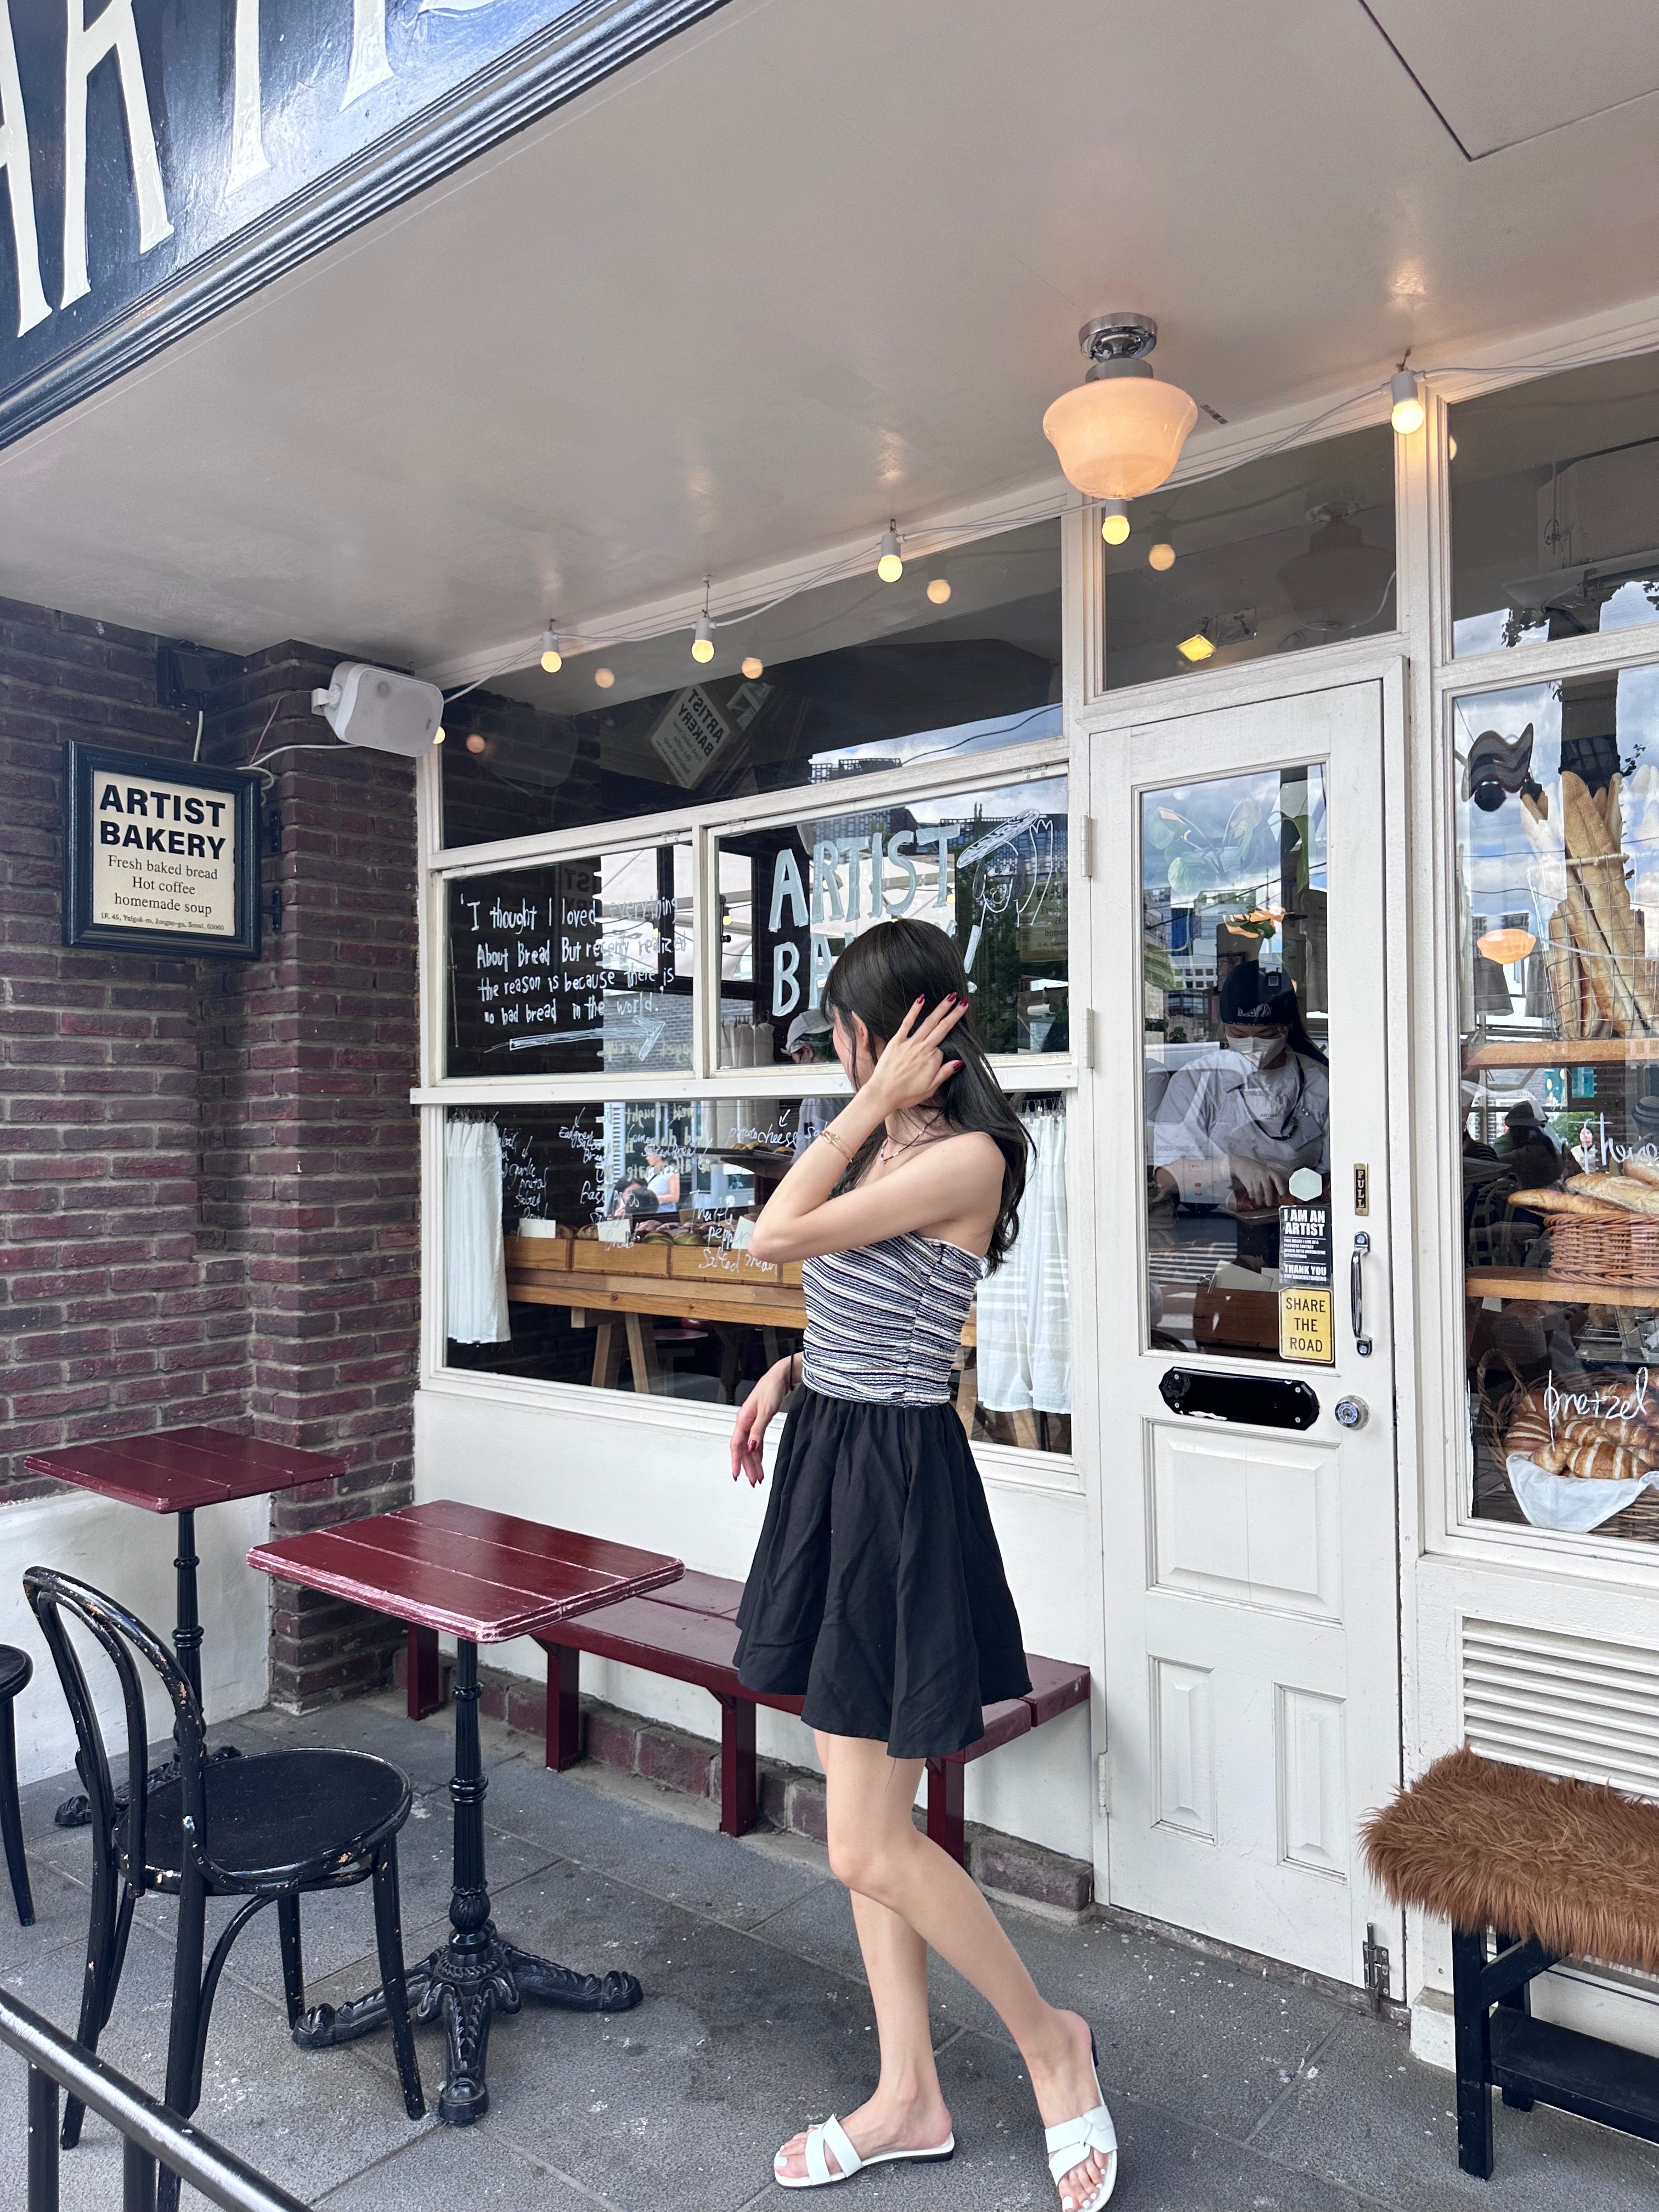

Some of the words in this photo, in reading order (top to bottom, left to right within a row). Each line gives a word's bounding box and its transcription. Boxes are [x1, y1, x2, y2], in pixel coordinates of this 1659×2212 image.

[99, 785, 225, 827] ARTIST
[100, 821, 225, 860] BAKERY
[108, 855, 142, 871] Fresh
[146, 860, 182, 876] baked
[186, 865, 218, 880] bread
[769, 824, 960, 932] ARTIST
[132, 876, 155, 890] Hot
[159, 881, 195, 895] coffee
[115, 893, 180, 911] homemade
[185, 903, 212, 917] soup
[489, 897, 537, 934] thought
[562, 898, 596, 927] loved
[609, 895, 678, 924] everything
[477, 943, 509, 973] About
[518, 939, 550, 967] Bread
[562, 937, 581, 962] But
[586, 934, 629, 957] recently
[639, 931, 686, 956] realized
[477, 977, 499, 1002] the
[504, 976, 540, 995] reason
[548, 975, 559, 992] is
[565, 971, 614, 992] because
[624, 963, 656, 988] there
[663, 967, 674, 986] is
[484, 1011, 494, 1024] no
[501, 1003, 518, 1025] bad
[526, 998, 557, 1025] bread
[573, 1002, 581, 1020] in
[584, 994, 605, 1020] the
[758, 1124, 798, 1148] cheese
[1284, 1209, 1288, 1221] I
[1290, 1209, 1307, 1222] AM
[1310, 1210, 1325, 1223] AN
[1285, 1222, 1325, 1236] ARTIST
[1284, 1263, 1310, 1274] THANK
[1311, 1266, 1327, 1276] YOU
[1286, 1297, 1326, 1313] SHARE
[1294, 1317, 1318, 1332] THE
[1290, 1337, 1323, 1352] ROAD
[1544, 1367, 1648, 1452] pretzel
